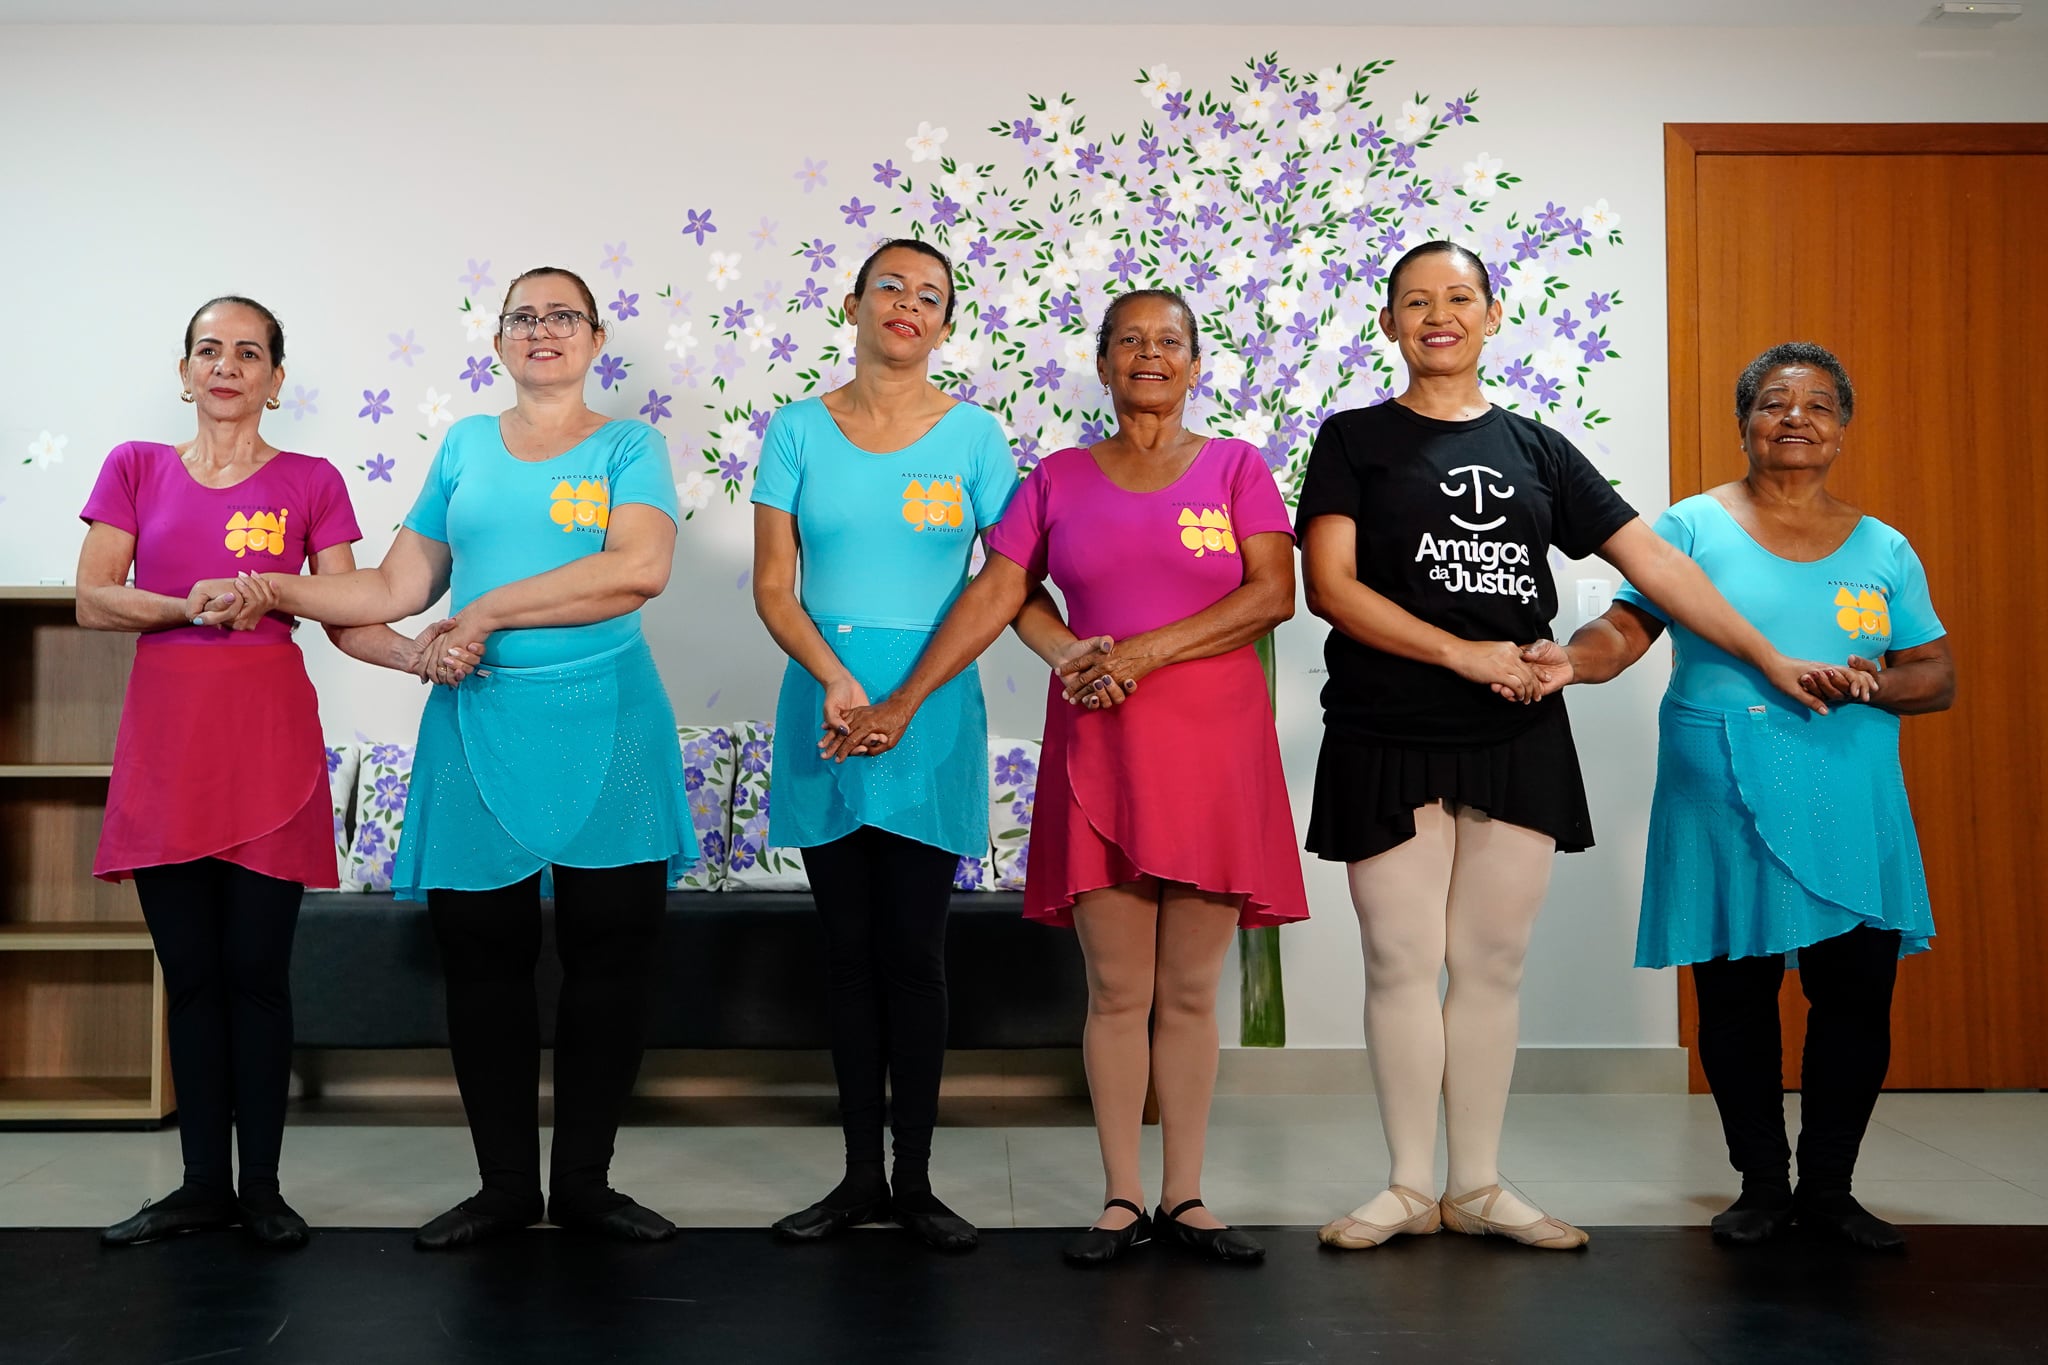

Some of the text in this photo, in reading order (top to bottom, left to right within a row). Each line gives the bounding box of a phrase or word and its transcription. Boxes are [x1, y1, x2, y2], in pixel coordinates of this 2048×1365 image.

[901, 472, 954, 480] ASSOCIAÇÃO
[1415, 532, 1530, 571] Amigos
[1428, 565, 1450, 581] da
